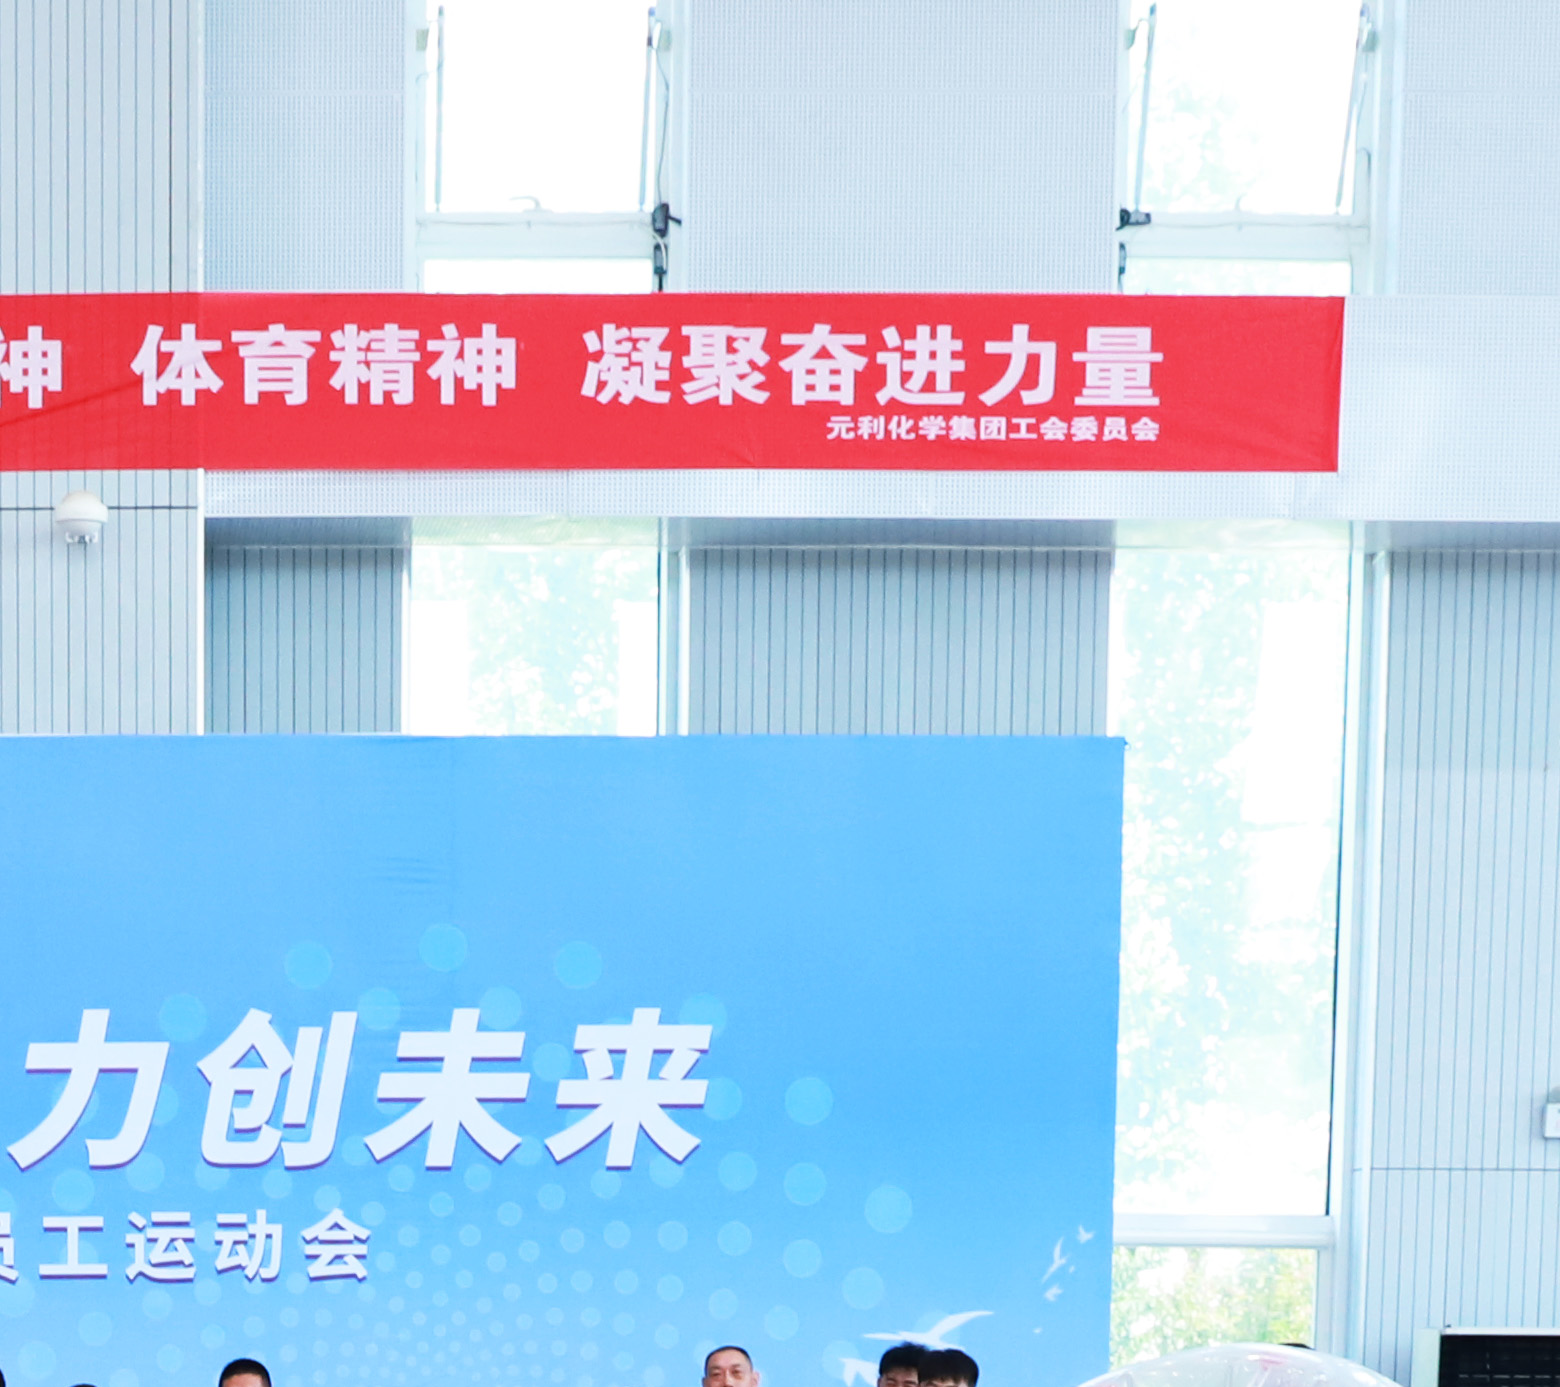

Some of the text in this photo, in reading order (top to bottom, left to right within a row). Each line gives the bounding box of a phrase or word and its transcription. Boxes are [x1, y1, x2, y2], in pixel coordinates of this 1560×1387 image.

[130, 323, 518, 407] 体育精神
[580, 323, 1163, 407] 凝聚奋进力量
[826, 415, 1160, 442] 元利化学集团工会委员会
